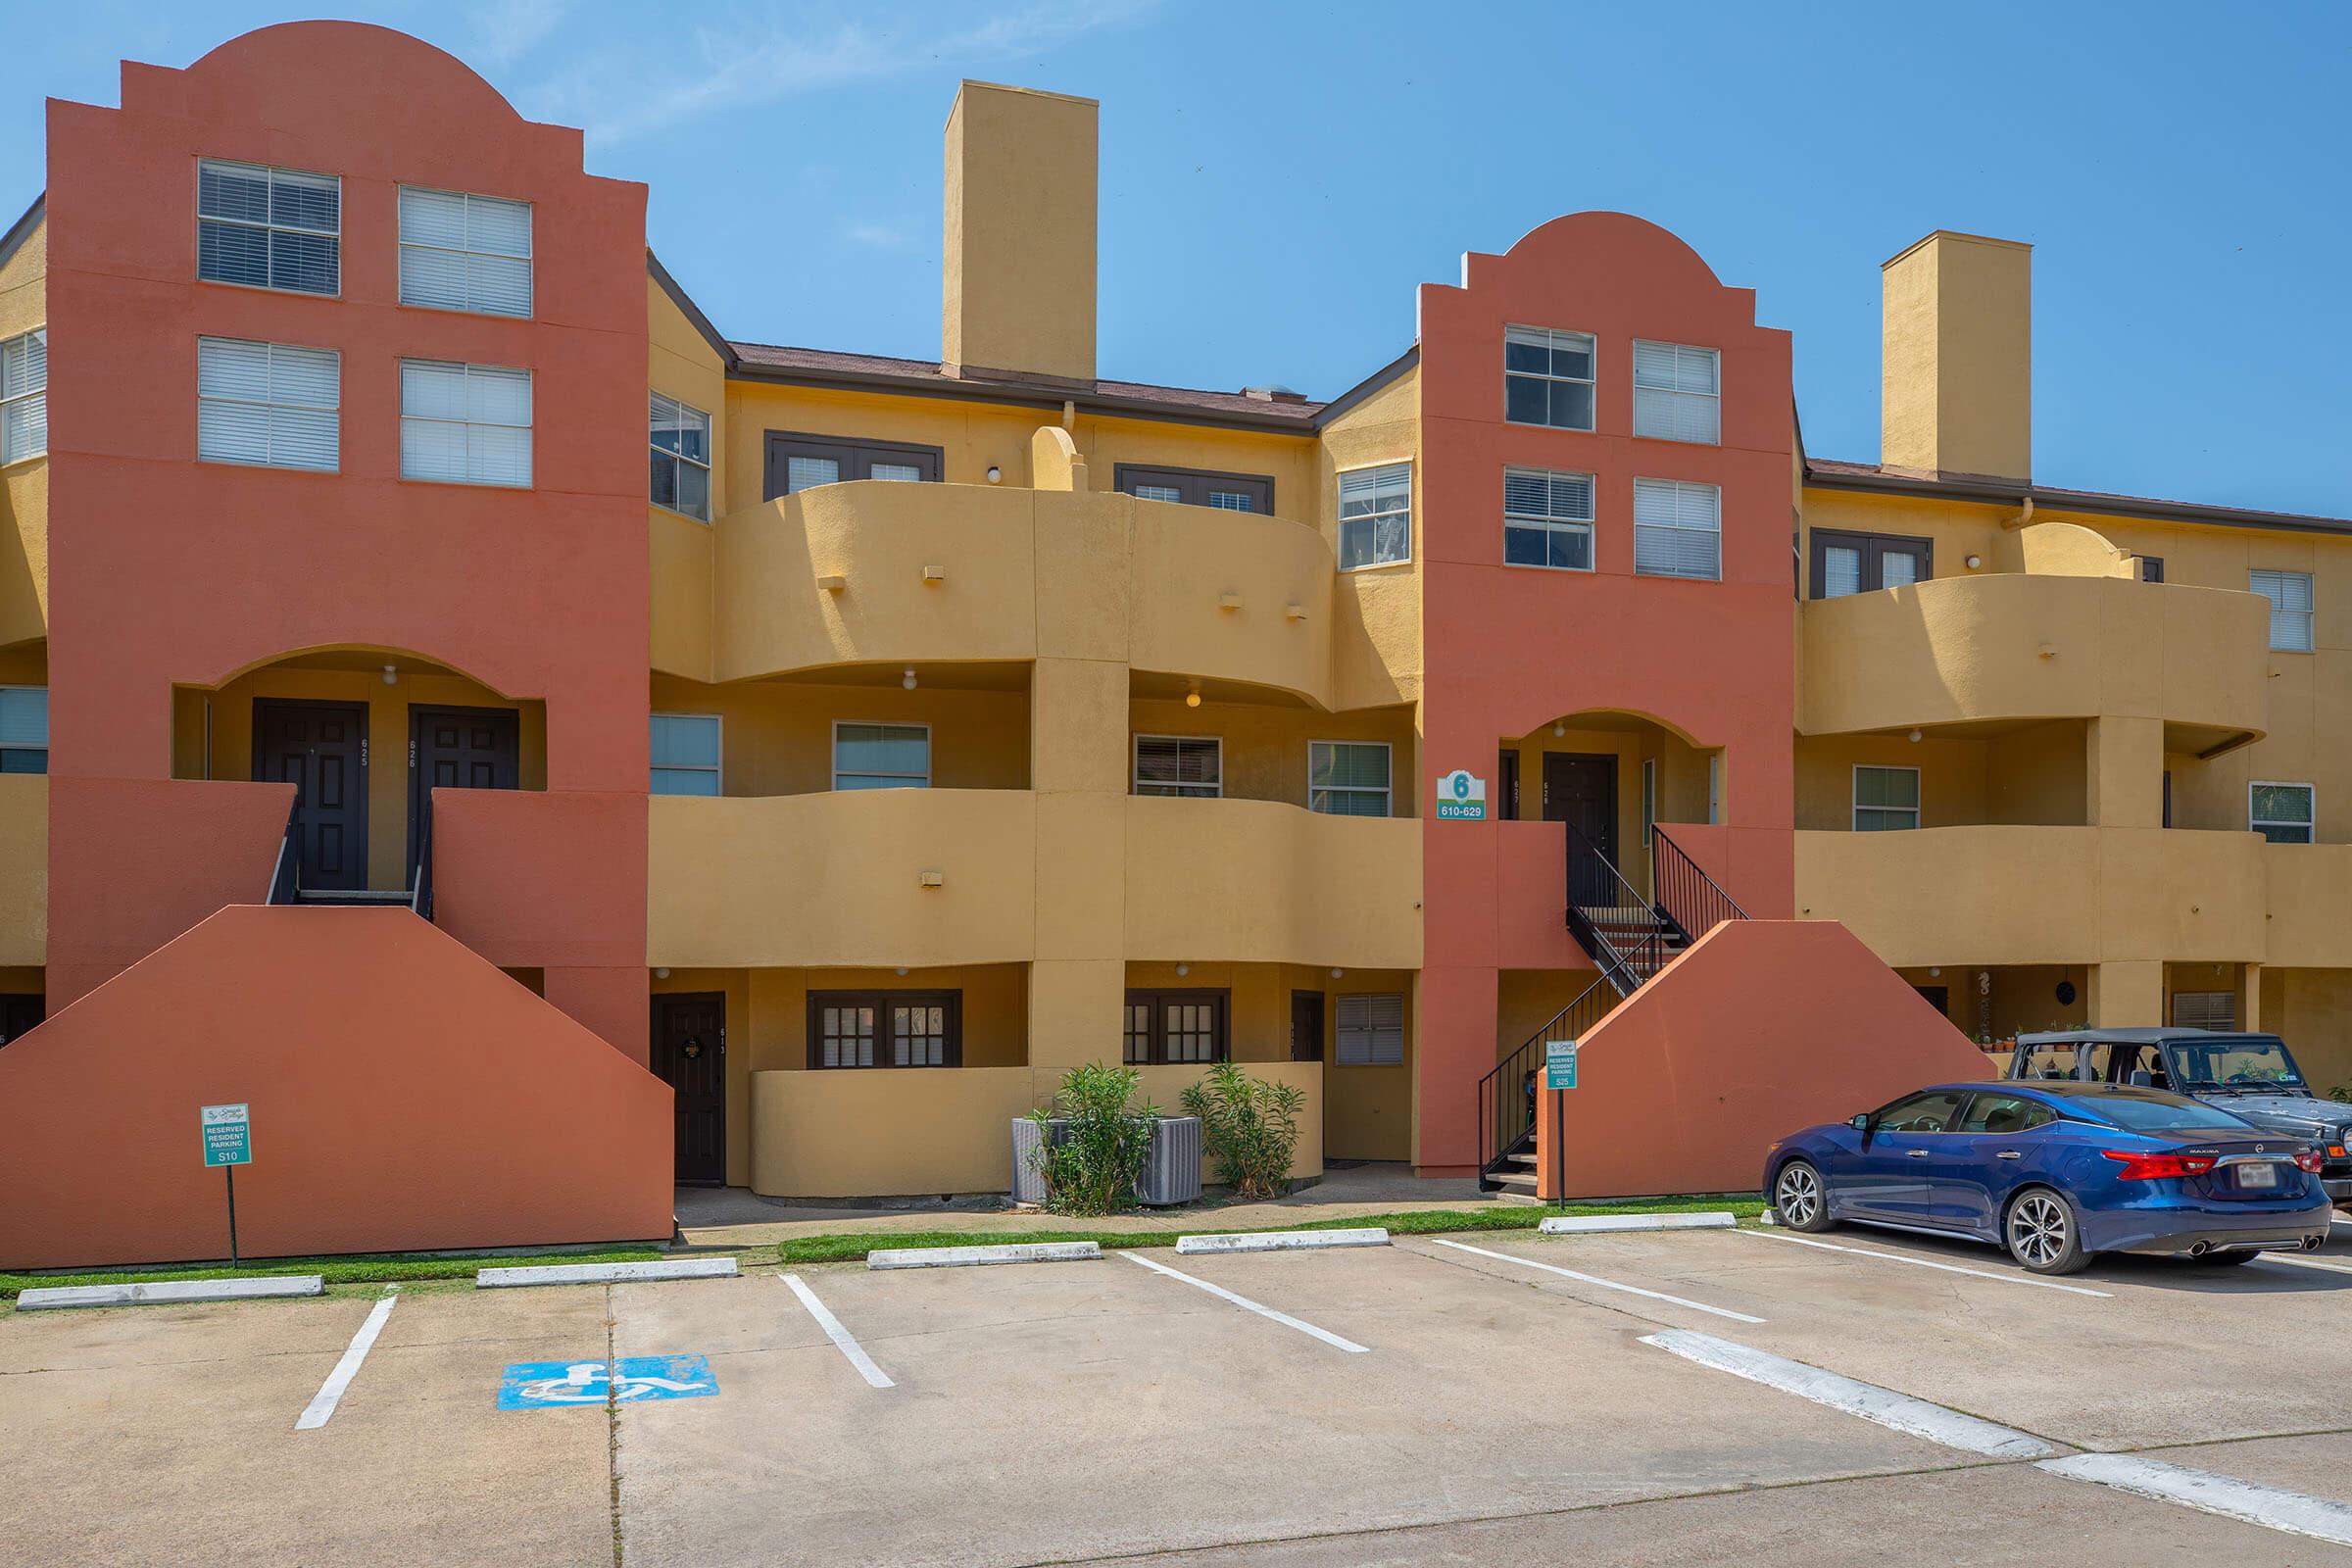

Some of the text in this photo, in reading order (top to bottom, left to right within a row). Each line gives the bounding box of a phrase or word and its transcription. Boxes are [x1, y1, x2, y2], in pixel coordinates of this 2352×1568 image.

[1453, 774, 1470, 799] 6
[1442, 806, 1482, 816] 610-629
[207, 1125, 245, 1135] RESERVED
[208, 1133, 244, 1142] RESIDENT
[211, 1140, 243, 1149] PARKING
[219, 1152, 238, 1162] S10
